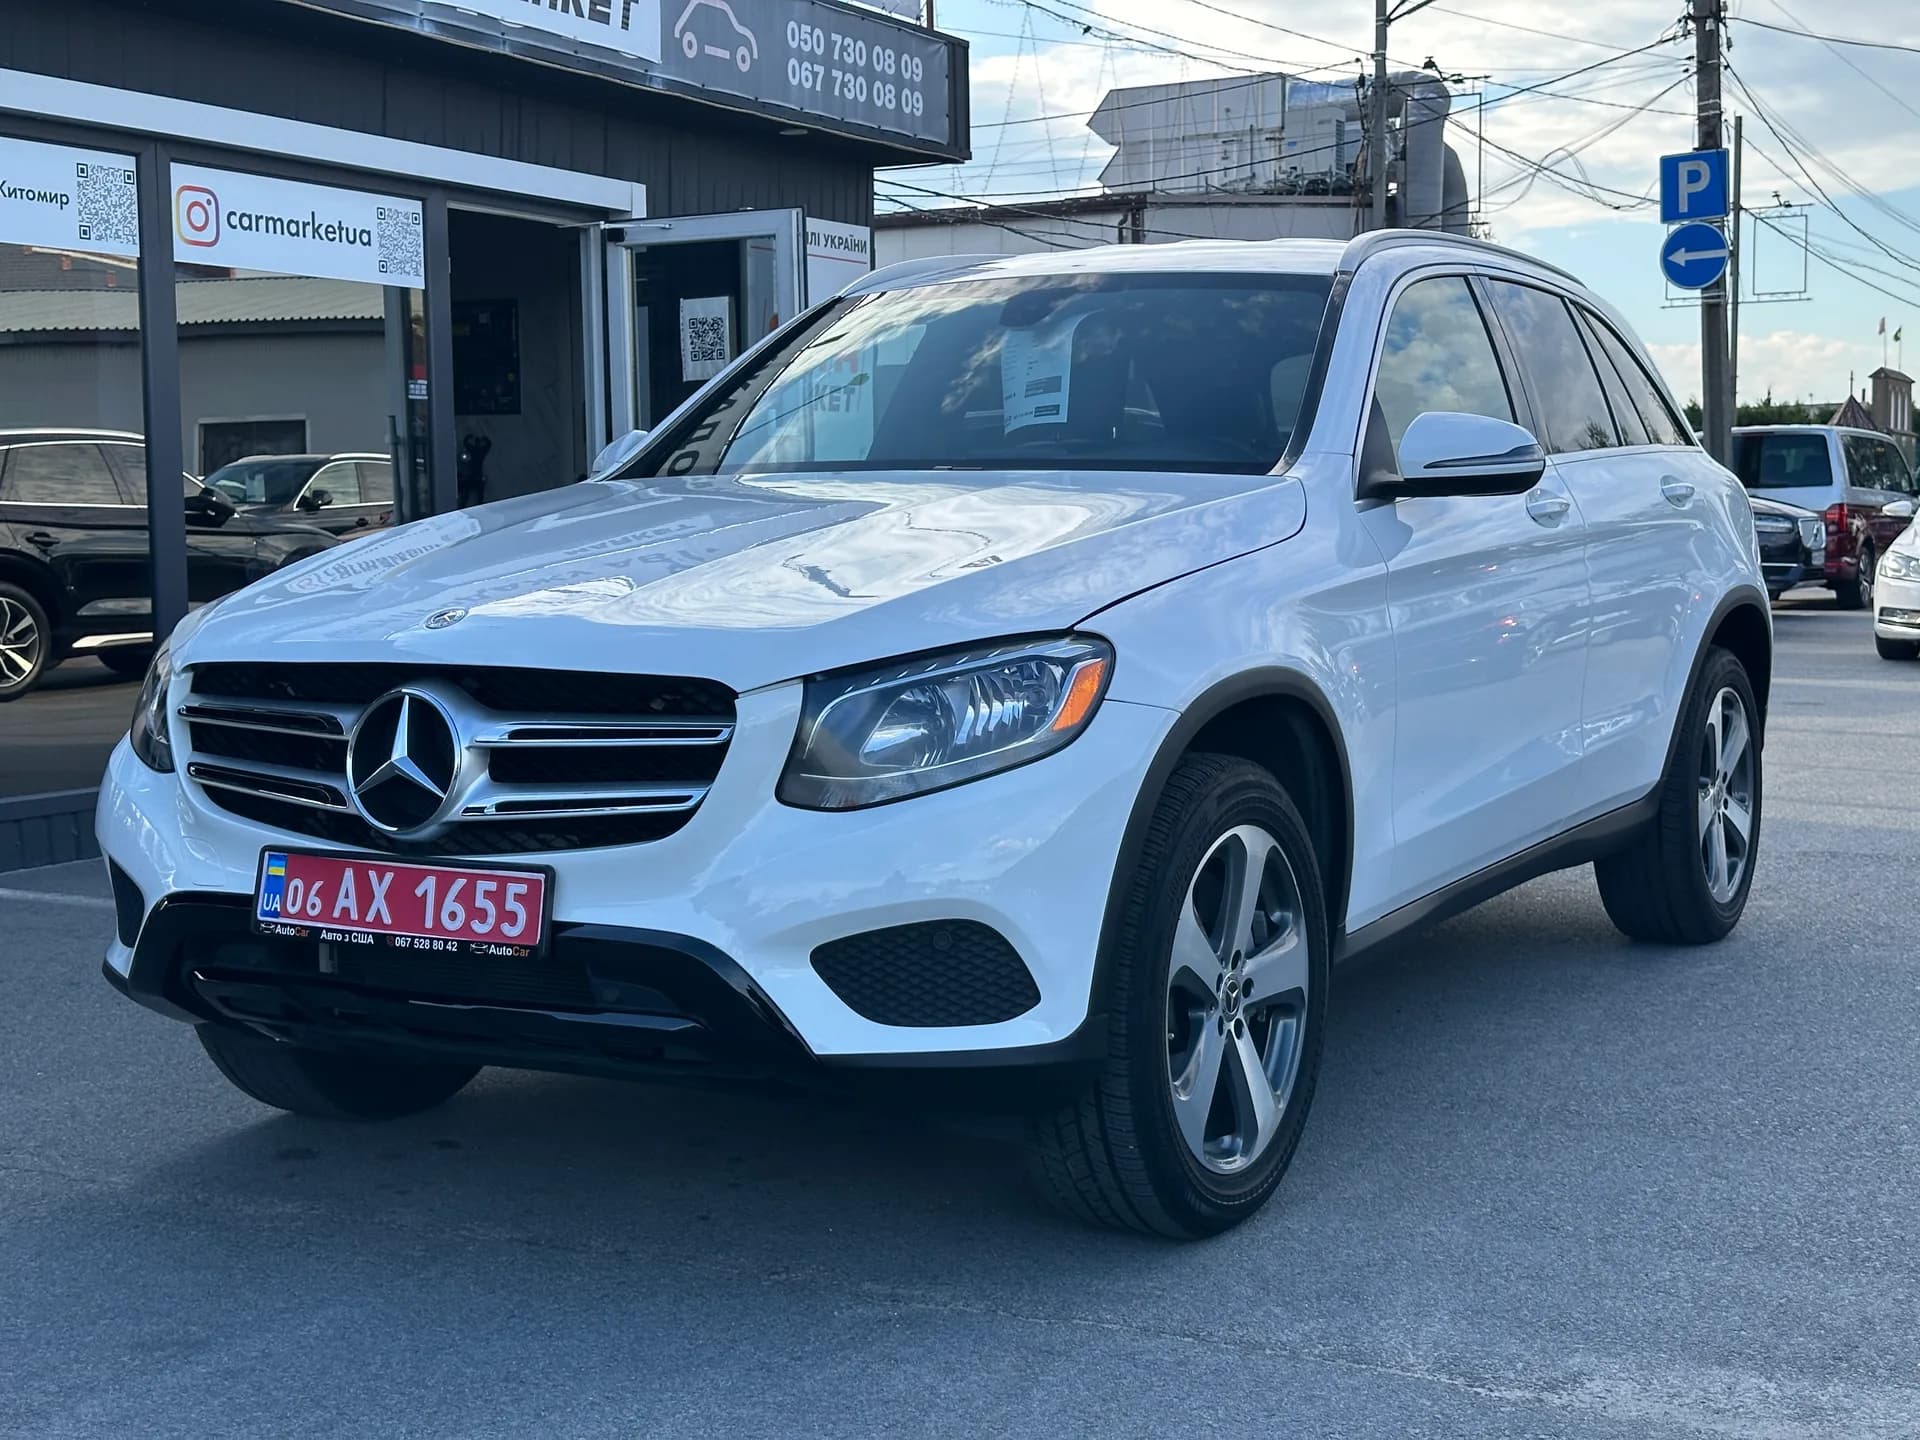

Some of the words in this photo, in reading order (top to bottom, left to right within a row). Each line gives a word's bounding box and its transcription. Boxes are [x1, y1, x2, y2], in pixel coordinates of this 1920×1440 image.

[787, 20, 825, 56] 050
[831, 32, 867, 67] 730
[872, 45, 896, 75] 08
[901, 53, 923, 82] 09
[787, 57, 825, 92] 067
[831, 69, 867, 103] 730
[873, 80, 896, 110] 08
[901, 88, 924, 117] 09
[1677, 159, 1711, 214] P
[226, 210, 372, 247] carmarketua
[806, 231, 820, 247] ЛІ
[823, 233, 867, 255] УКРАЇНИ
[262, 892, 281, 912] UA
[286, 878, 323, 917] 06
[332, 867, 394, 925] AX
[414, 876, 528, 938] 1655
[275, 924, 310, 937] AutoCar
[320, 929, 343, 942] Авто
[351, 932, 375, 945] США
[394, 936, 411, 948] 067
[413, 938, 430, 950] 528
[432, 939, 444, 951] 80
[446, 940, 458, 952] 42
[488, 944, 530, 957] AutoCar
